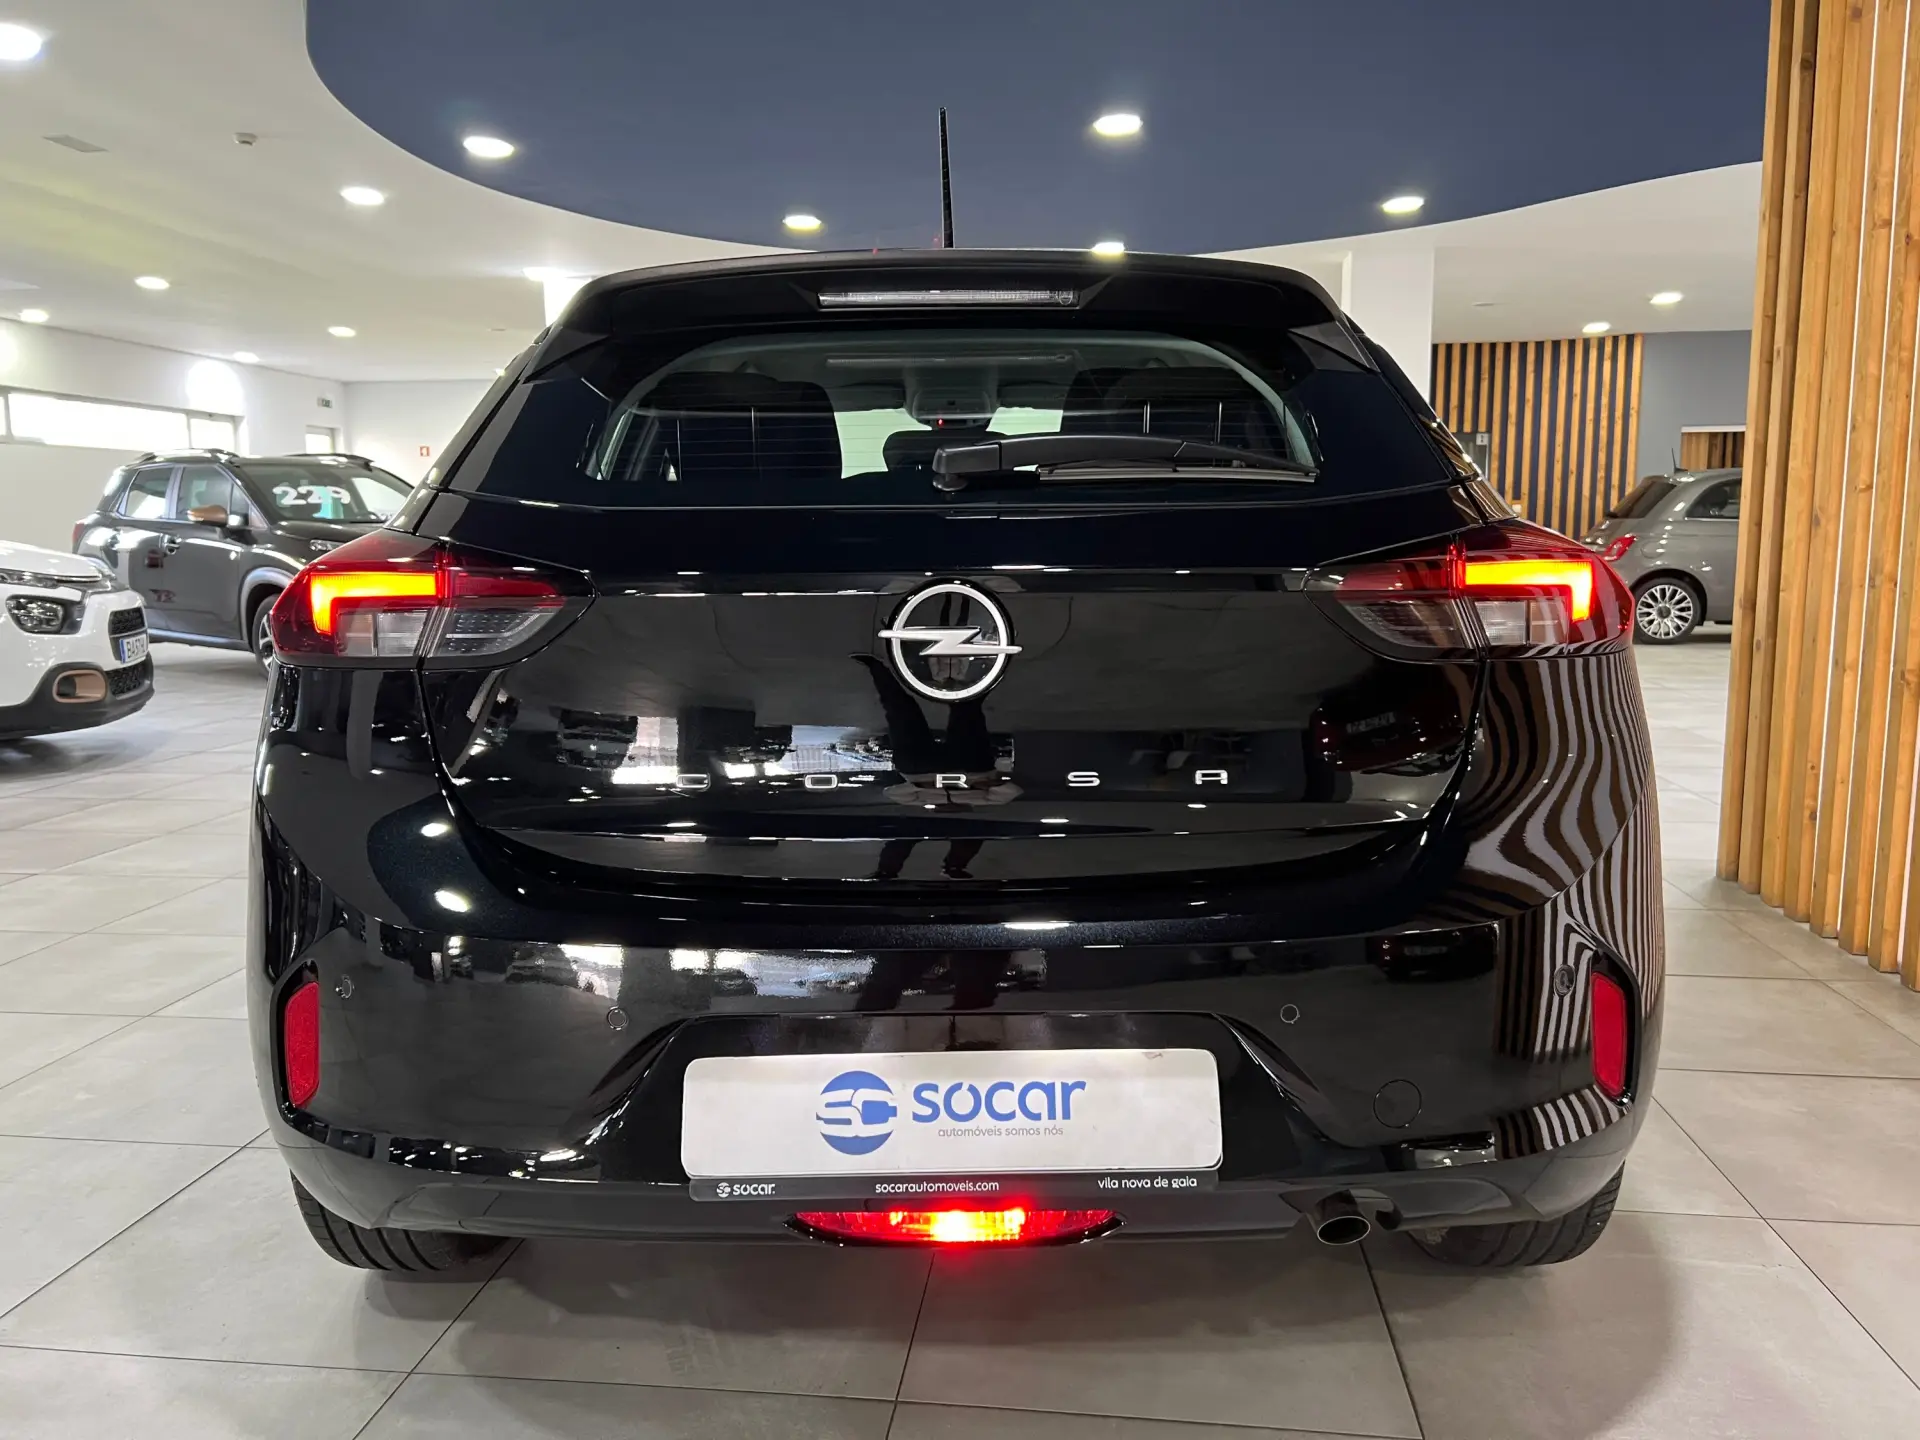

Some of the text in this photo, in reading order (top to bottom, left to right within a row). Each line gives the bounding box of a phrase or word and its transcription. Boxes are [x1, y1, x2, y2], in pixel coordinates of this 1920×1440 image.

[676, 769, 1228, 789] CORSA
[912, 1080, 1087, 1123] socar
[938, 1125, 1064, 1138] automóveis somos nós
[875, 1181, 1000, 1193] socarautomoveis.com
[1098, 1175, 1198, 1189] vila nova de gaia
